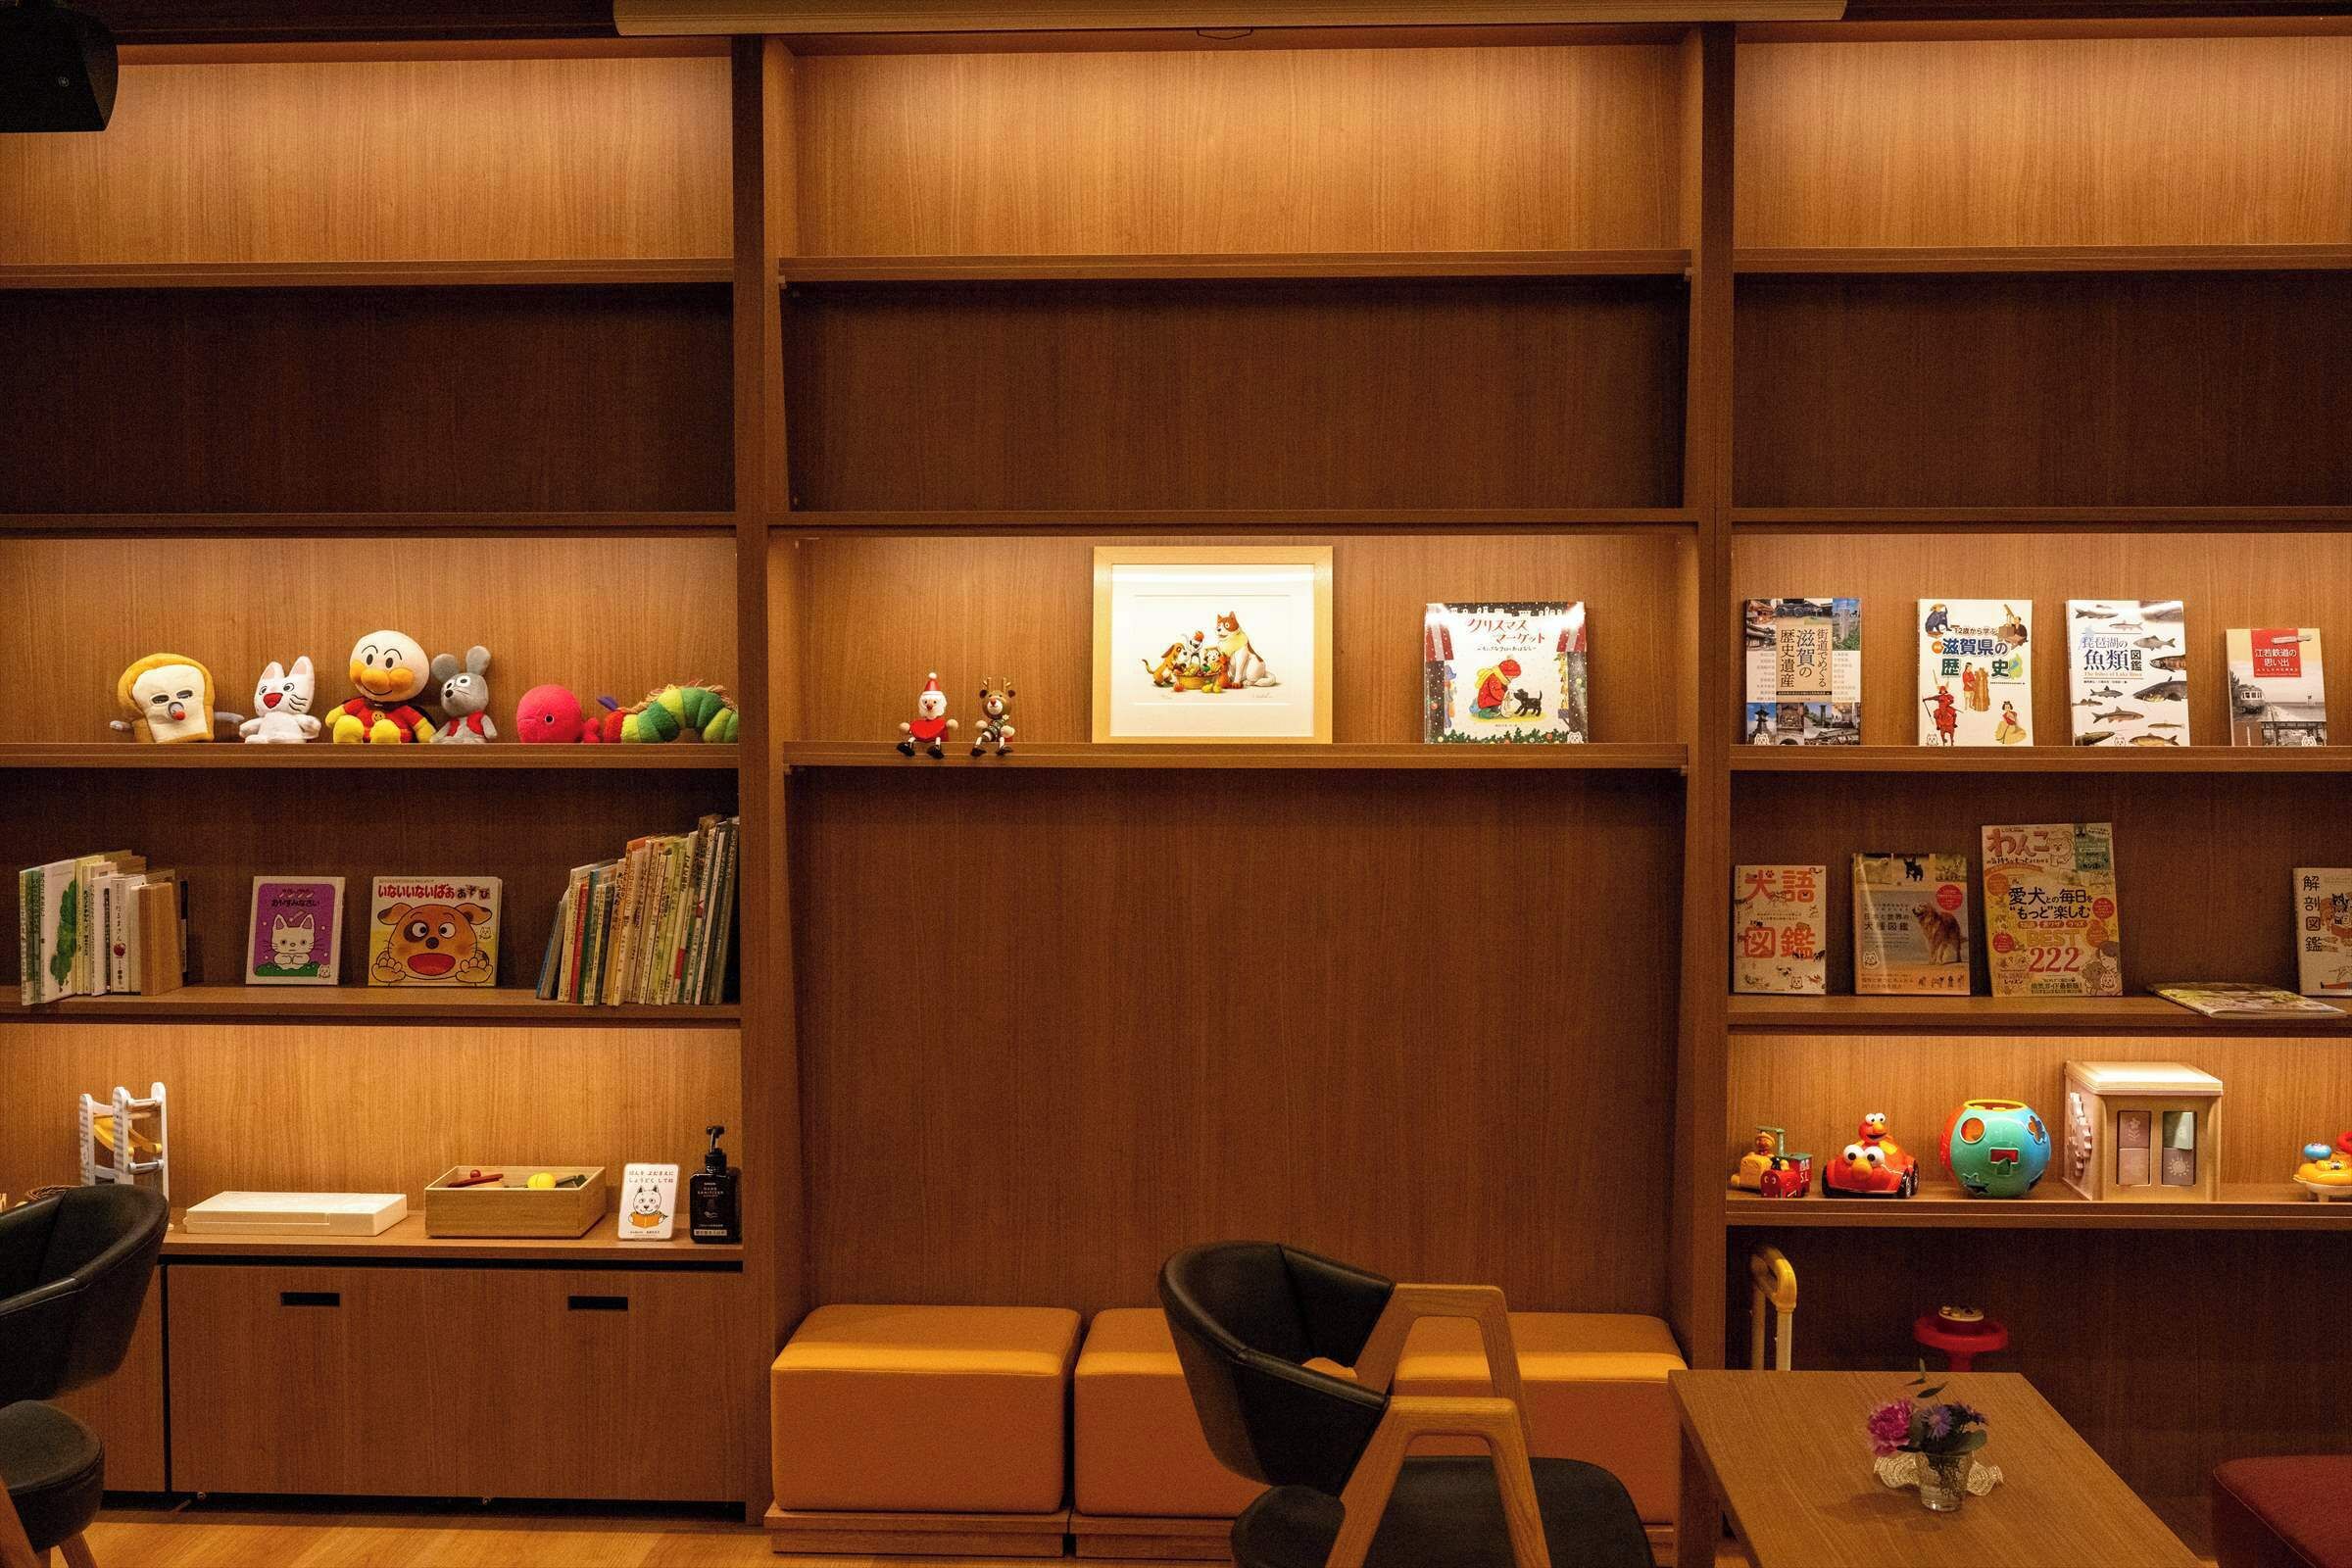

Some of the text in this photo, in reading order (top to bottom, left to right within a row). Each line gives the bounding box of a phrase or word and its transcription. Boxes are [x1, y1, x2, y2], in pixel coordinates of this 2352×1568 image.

[1467, 618, 1529, 633] クリスマス
[1495, 632, 1545, 644] マーケット
[1796, 629, 1816, 678] 滋賀の
[1942, 638, 2008, 656] 滋賀県の
[2082, 637, 2129, 649] 琵琶湖の
[1780, 629, 1795, 688] 歴史遺産
[1817, 628, 1829, 688] 街道でめぐる
[1986, 828, 2050, 858] わんこ
[1744, 869, 1816, 904] 犬語
[2009, 887, 2093, 906] 愛犬との毎日を
[2303, 875, 2323, 953] 解剖図鑑
[1744, 926, 1816, 959] 図鑑
[2026, 930, 2079, 947] BEST
[2028, 947, 2081, 972] 222
